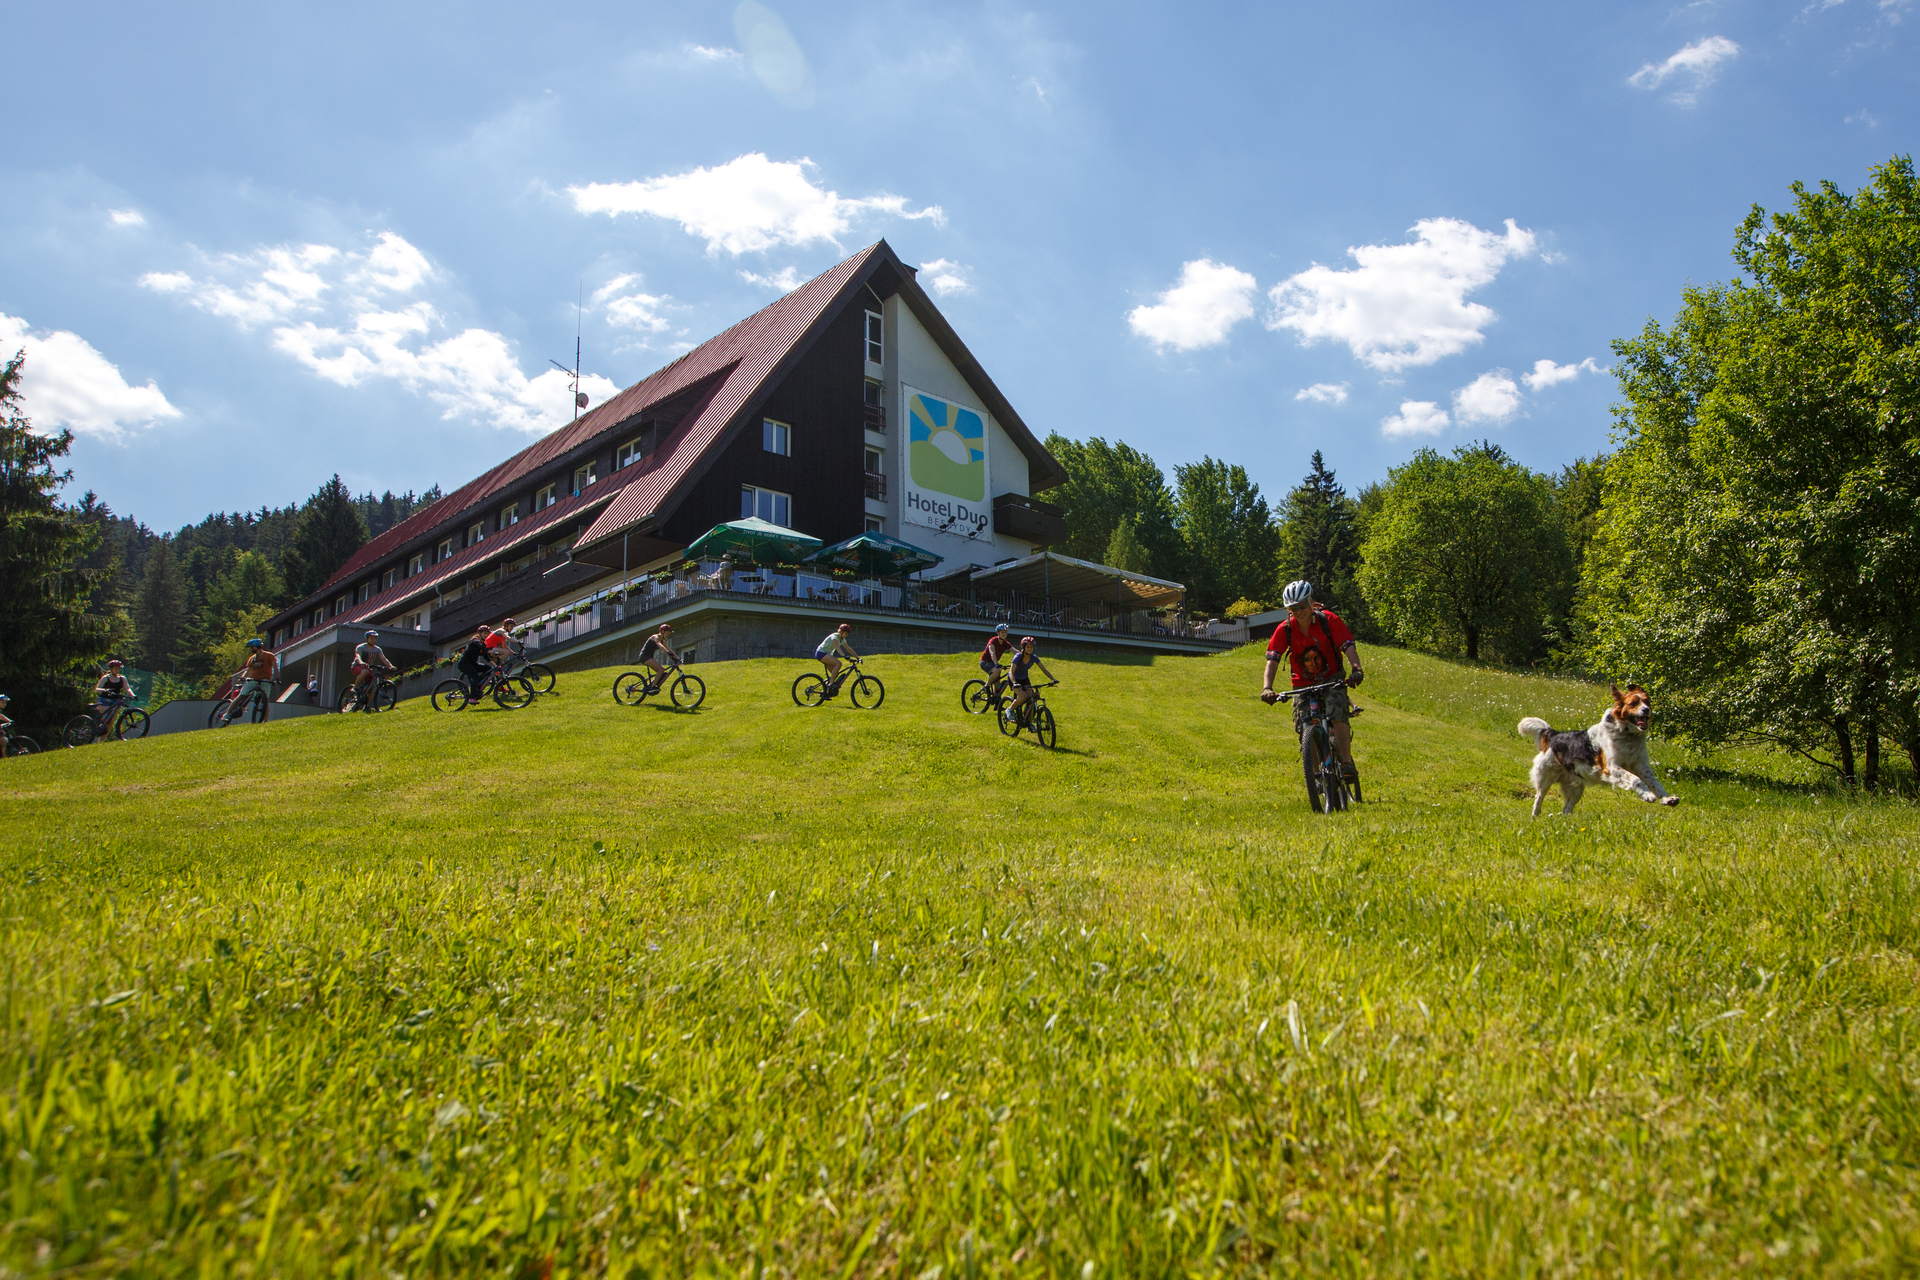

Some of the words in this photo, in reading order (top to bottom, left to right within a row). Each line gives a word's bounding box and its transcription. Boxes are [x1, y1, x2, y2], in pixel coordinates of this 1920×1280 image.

[908, 491, 951, 517] Hotel
[957, 504, 989, 527] Duo
[927, 516, 971, 533] BESYDY
